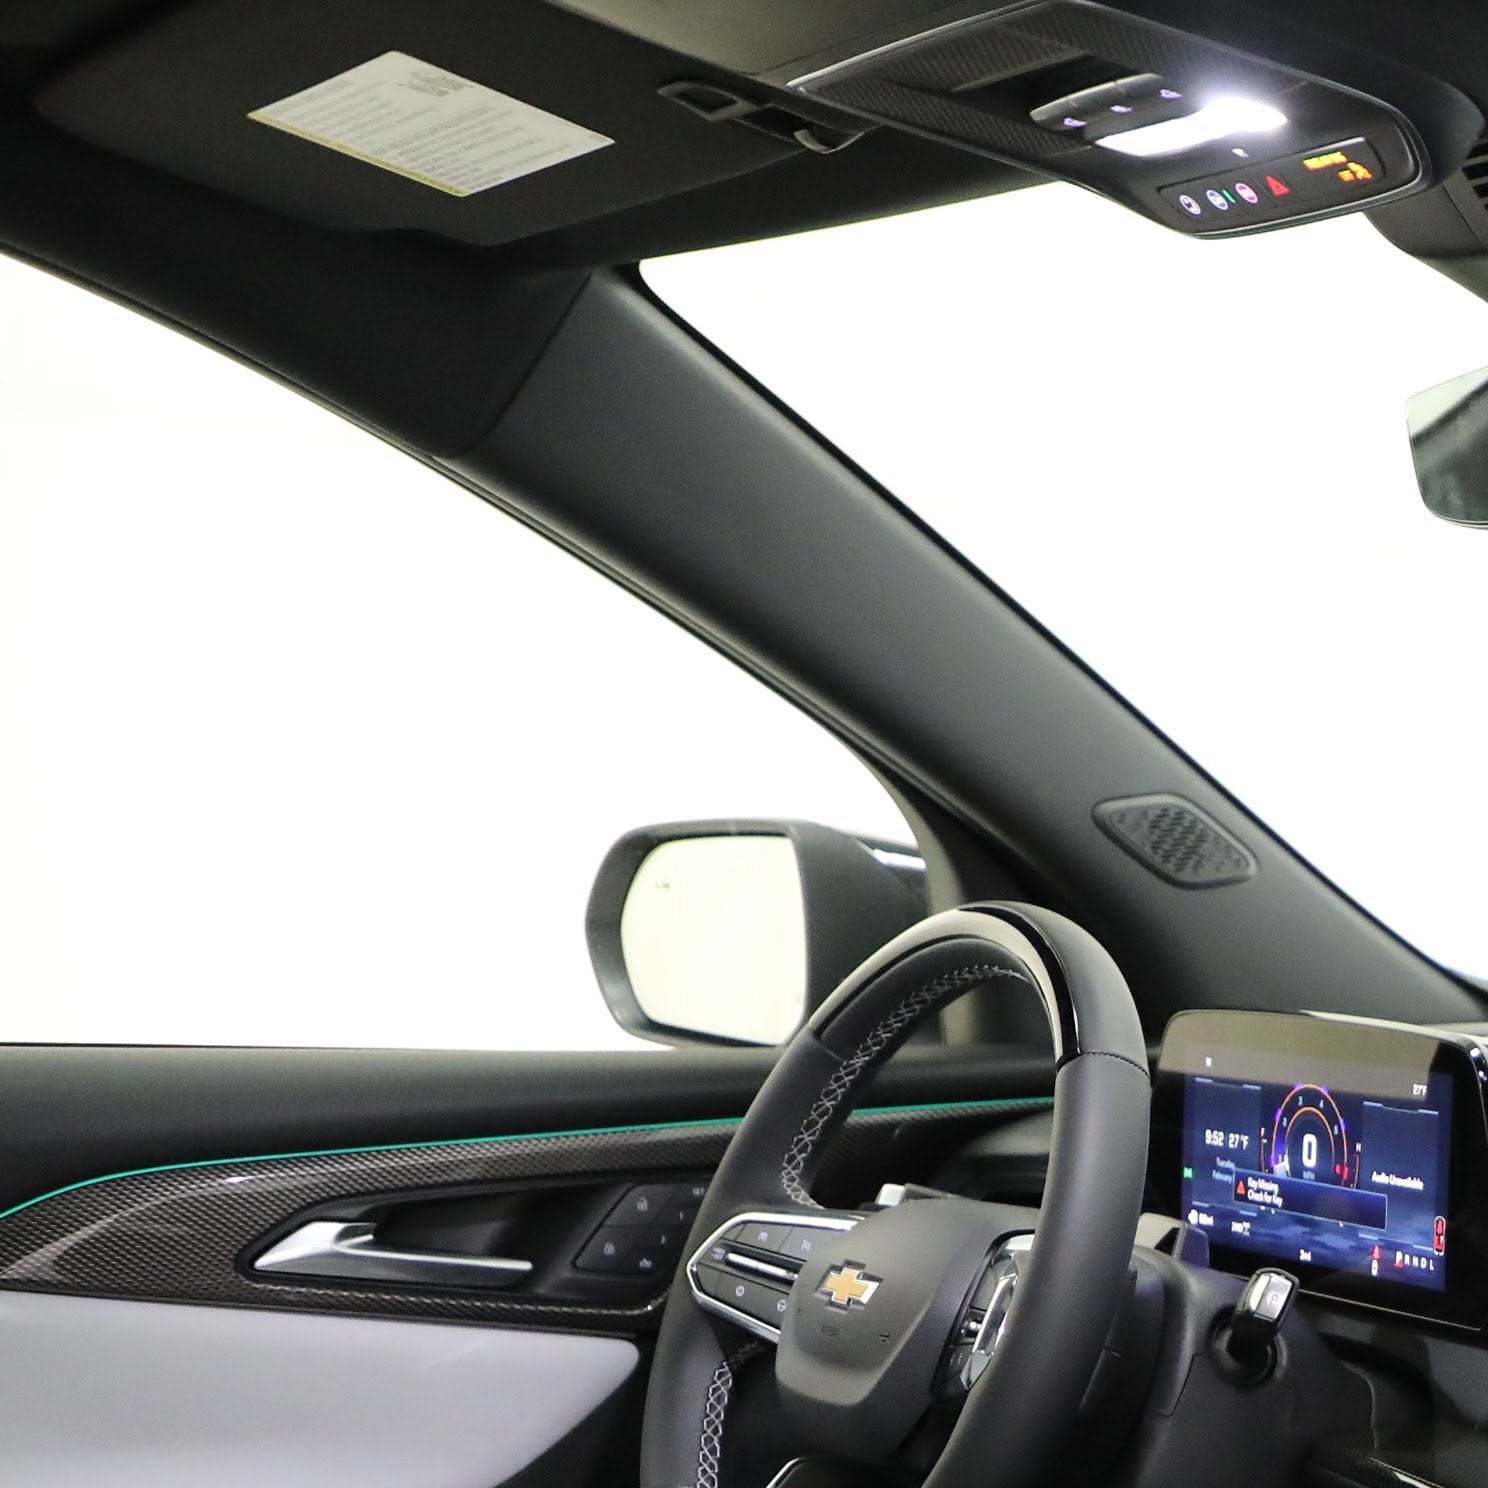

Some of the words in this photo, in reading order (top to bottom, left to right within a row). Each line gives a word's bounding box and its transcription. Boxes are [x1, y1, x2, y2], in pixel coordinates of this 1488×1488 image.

[1204, 1129, 1224, 1147] 9:52
[1228, 1133, 1240, 1148] 27
[1302, 1133, 1317, 1168] 0
[1212, 1170, 1233, 1184] February
[1303, 1172, 1316, 1180] MPH
[1371, 1171, 1389, 1184] Audio
[1390, 1174, 1424, 1190] Unavailable
[1248, 1176, 1258, 1190] Key
[1258, 1178, 1278, 1196] Missing
